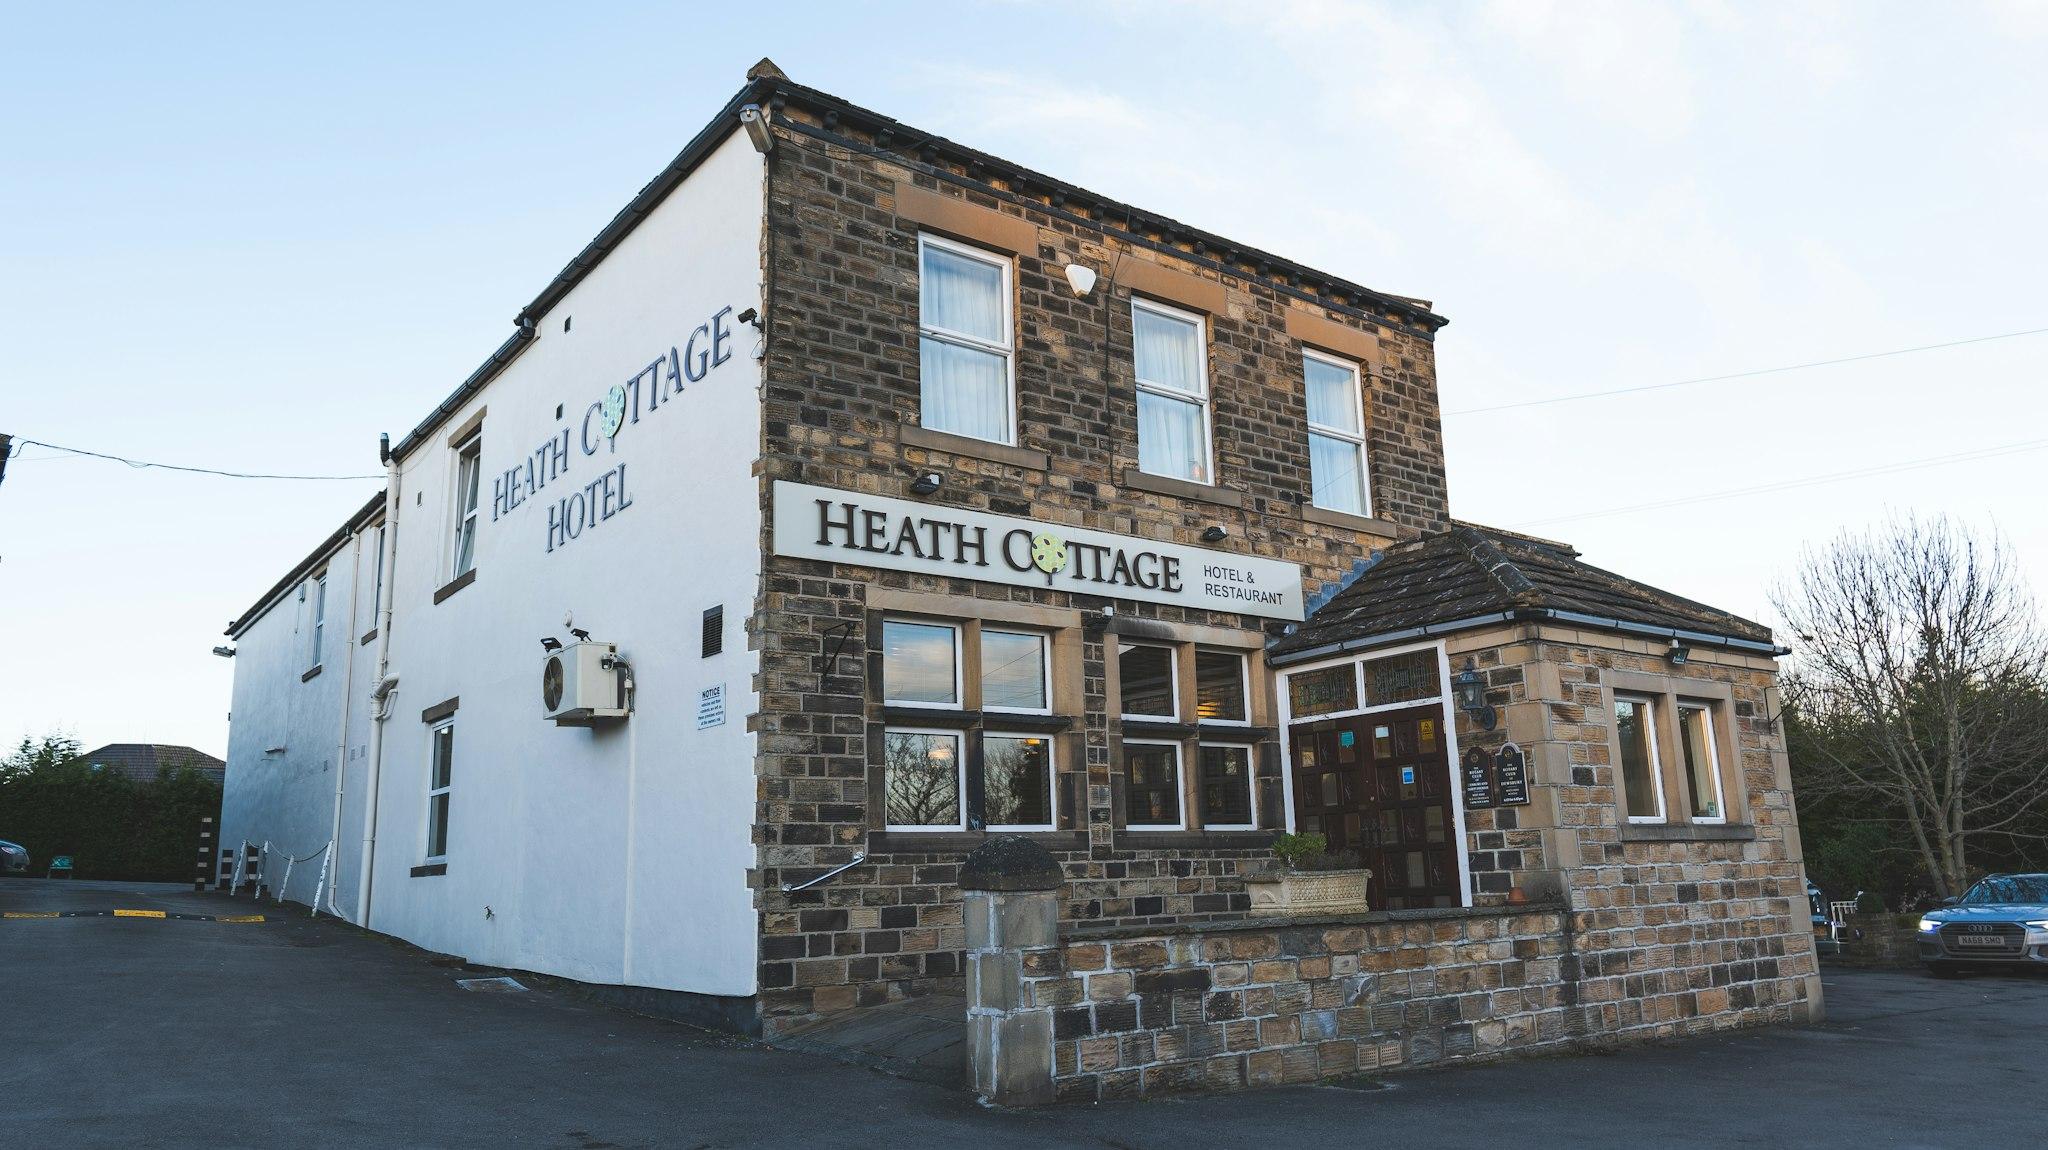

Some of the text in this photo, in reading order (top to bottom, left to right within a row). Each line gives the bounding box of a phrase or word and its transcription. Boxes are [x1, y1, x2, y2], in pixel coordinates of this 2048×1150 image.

[491, 427, 570, 522] HEATH
[547, 462, 633, 553] HOTEL
[815, 499, 990, 567] HEATH
[1203, 564, 1255, 584] HOTEL &
[1205, 582, 1283, 606] RESTAURANT
[702, 687, 720, 698] NOTICE
